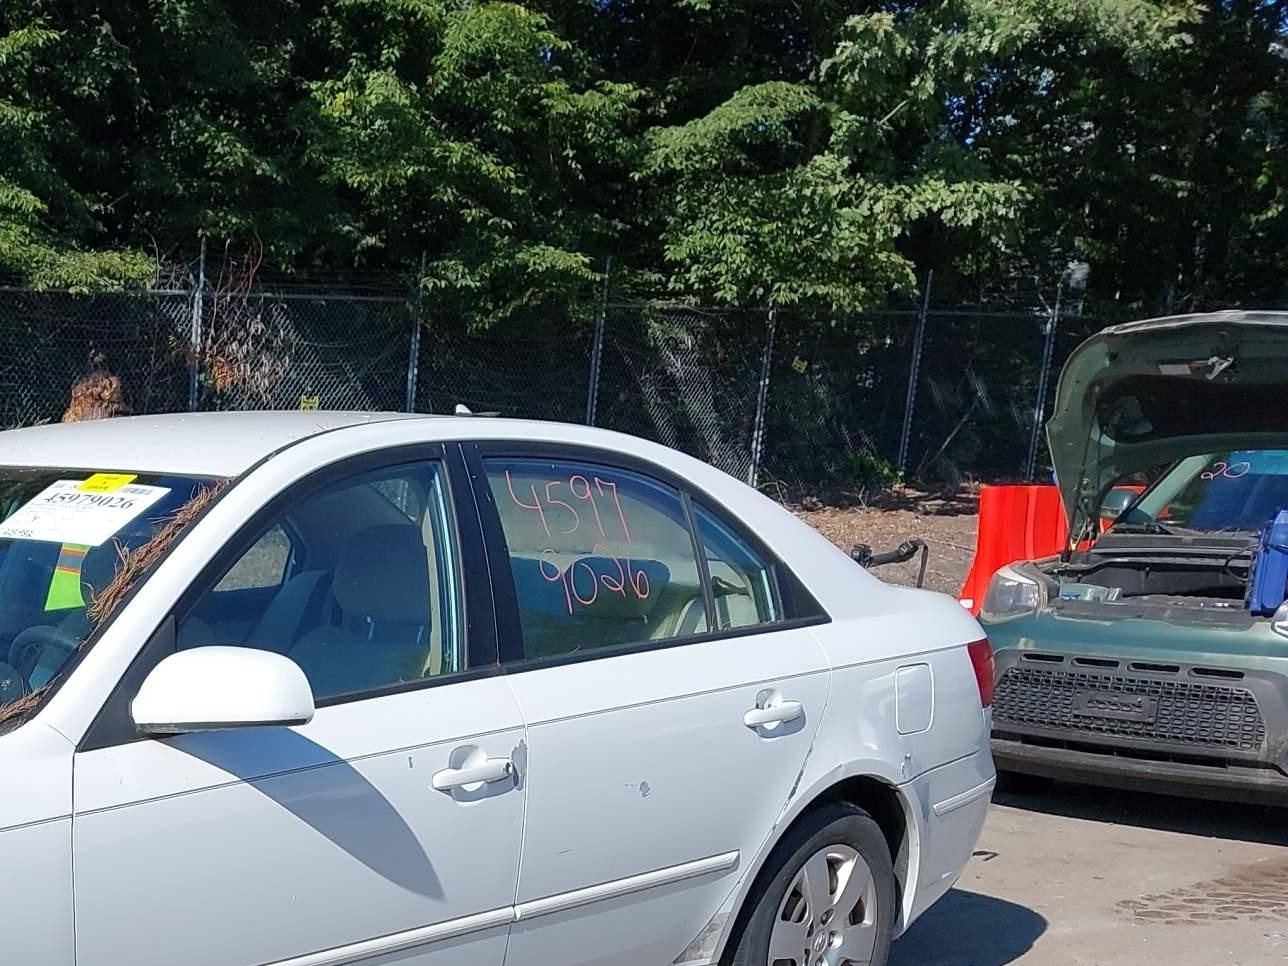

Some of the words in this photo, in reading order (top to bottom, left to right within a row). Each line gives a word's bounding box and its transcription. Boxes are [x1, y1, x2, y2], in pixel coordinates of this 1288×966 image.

[43, 492, 134, 510] 45979026
[505, 470, 631, 542] 4597
[539, 543, 650, 615] 9026
